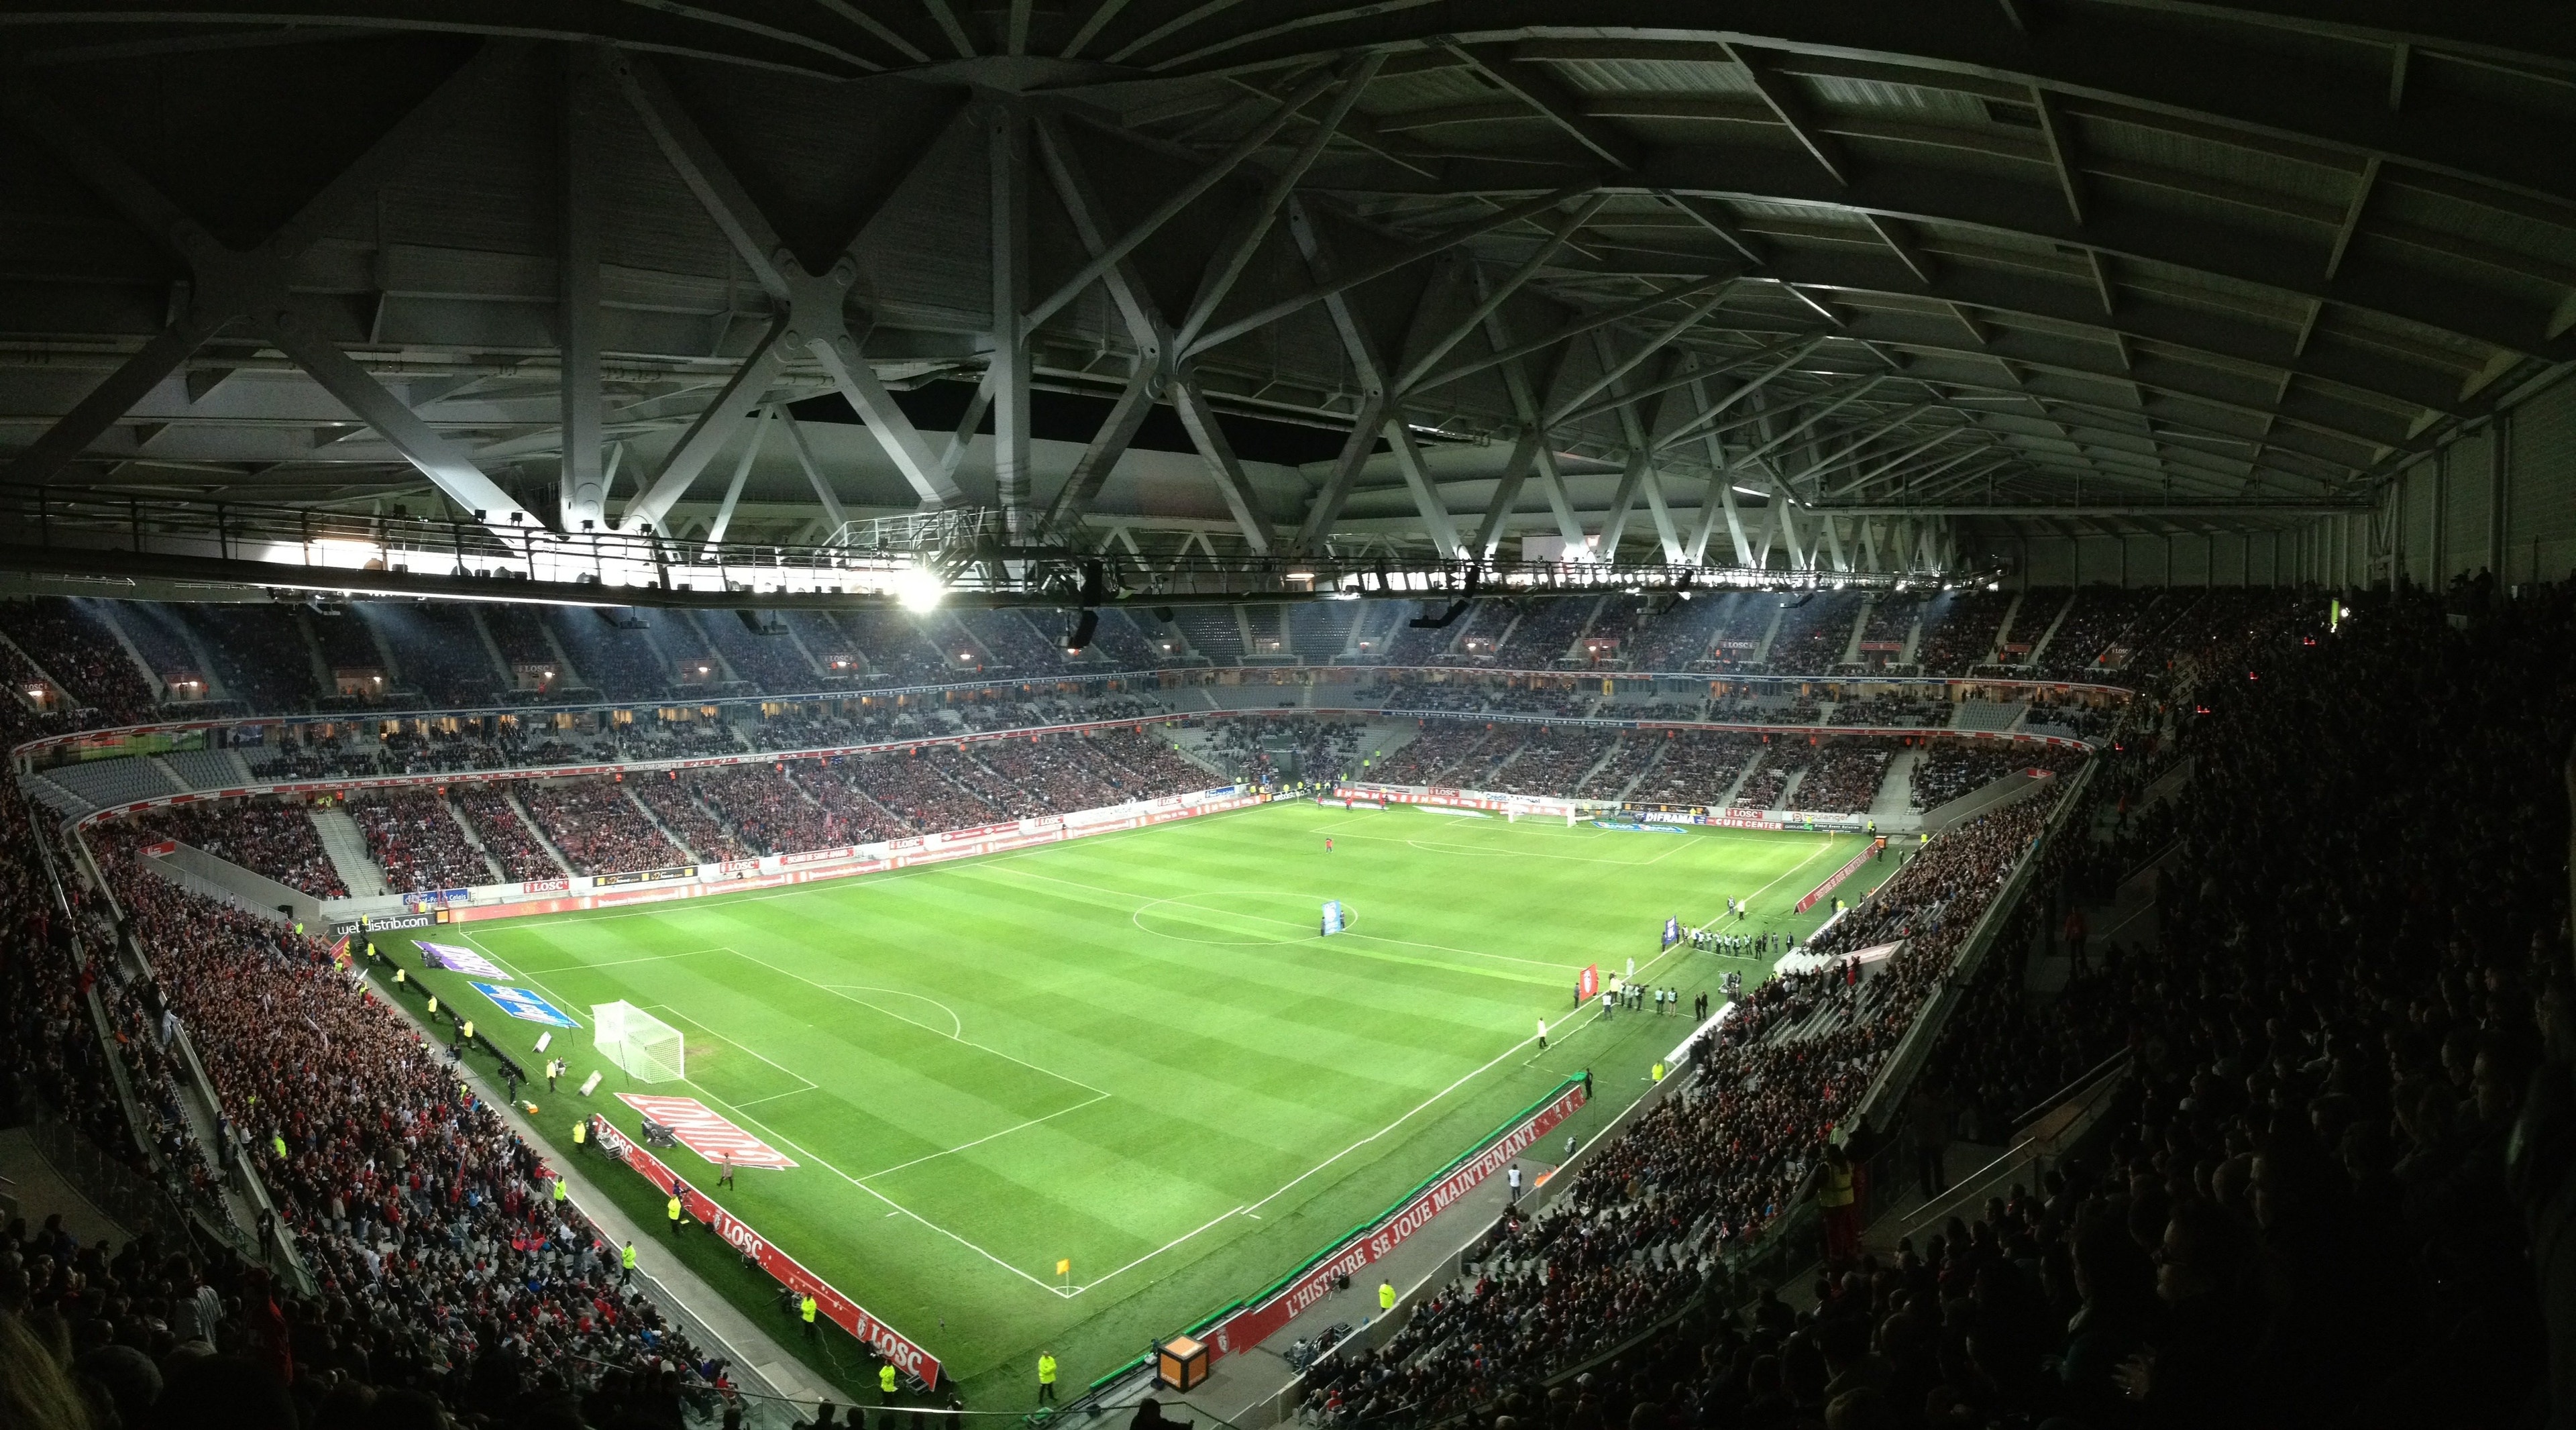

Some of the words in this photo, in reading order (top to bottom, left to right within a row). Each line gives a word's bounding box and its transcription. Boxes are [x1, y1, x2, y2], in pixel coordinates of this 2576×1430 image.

[1646, 813, 1695, 824] DIFRAMA
[1733, 810, 1758, 818] LOSC
[1715, 818, 1743, 827] CUIR
[1746, 820, 1782, 830] CENTER
[897, 838, 920, 848] LOSC
[729, 860, 755, 871] LOSC
[534, 881, 564, 892] LOSC
[1286, 1248, 1366, 1318] L'HISTOIRE
[1371, 1233, 1391, 1259] SE
[1393, 1201, 1433, 1244] JOUE
[1432, 1121, 1536, 1212] MAINTENANT
[723, 1217, 763, 1260] LOSC
[870, 1323, 922, 1376] LOSC
